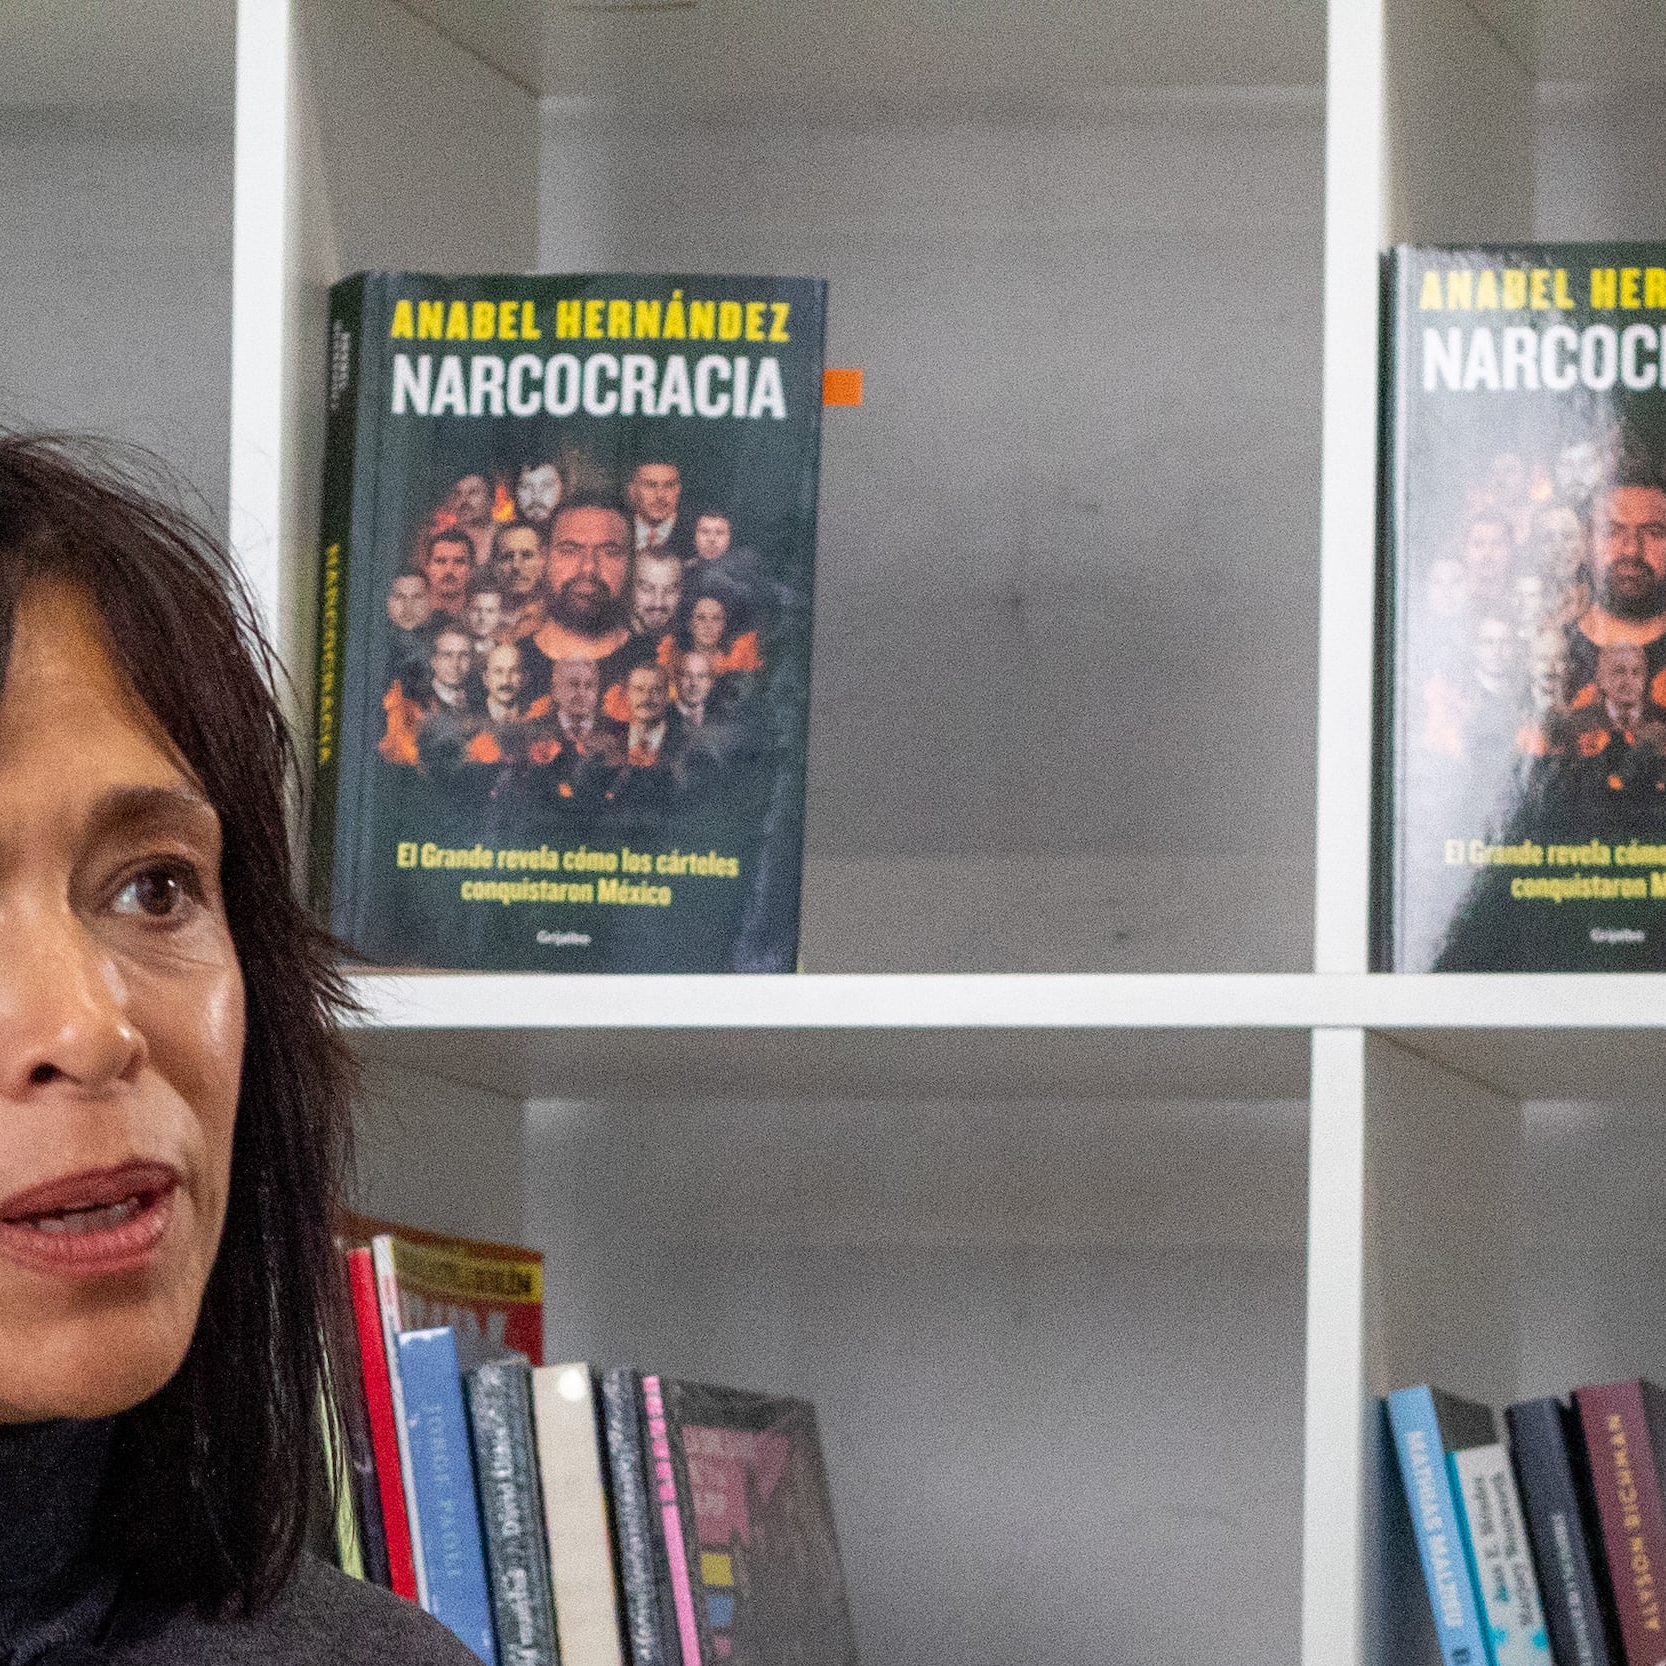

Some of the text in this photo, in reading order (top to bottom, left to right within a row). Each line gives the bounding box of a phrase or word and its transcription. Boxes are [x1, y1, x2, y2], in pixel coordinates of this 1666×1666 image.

[1419, 265, 1573, 310] ANABEL
[391, 290, 791, 344] ANABEL HERNÁNDEZ
[390, 353, 788, 420] NARCOCRACIA
[398, 843, 739, 878] El Grande revela cómo los cárteles
[1444, 838, 1465, 865] El
[461, 878, 672, 906] conquistaron México
[1510, 872, 1648, 902] conquistaron
[1406, 1430, 1462, 1628] MATHIAS MALZIEU
[1606, 1414, 1661, 1631] ALYSON RICHMAN
